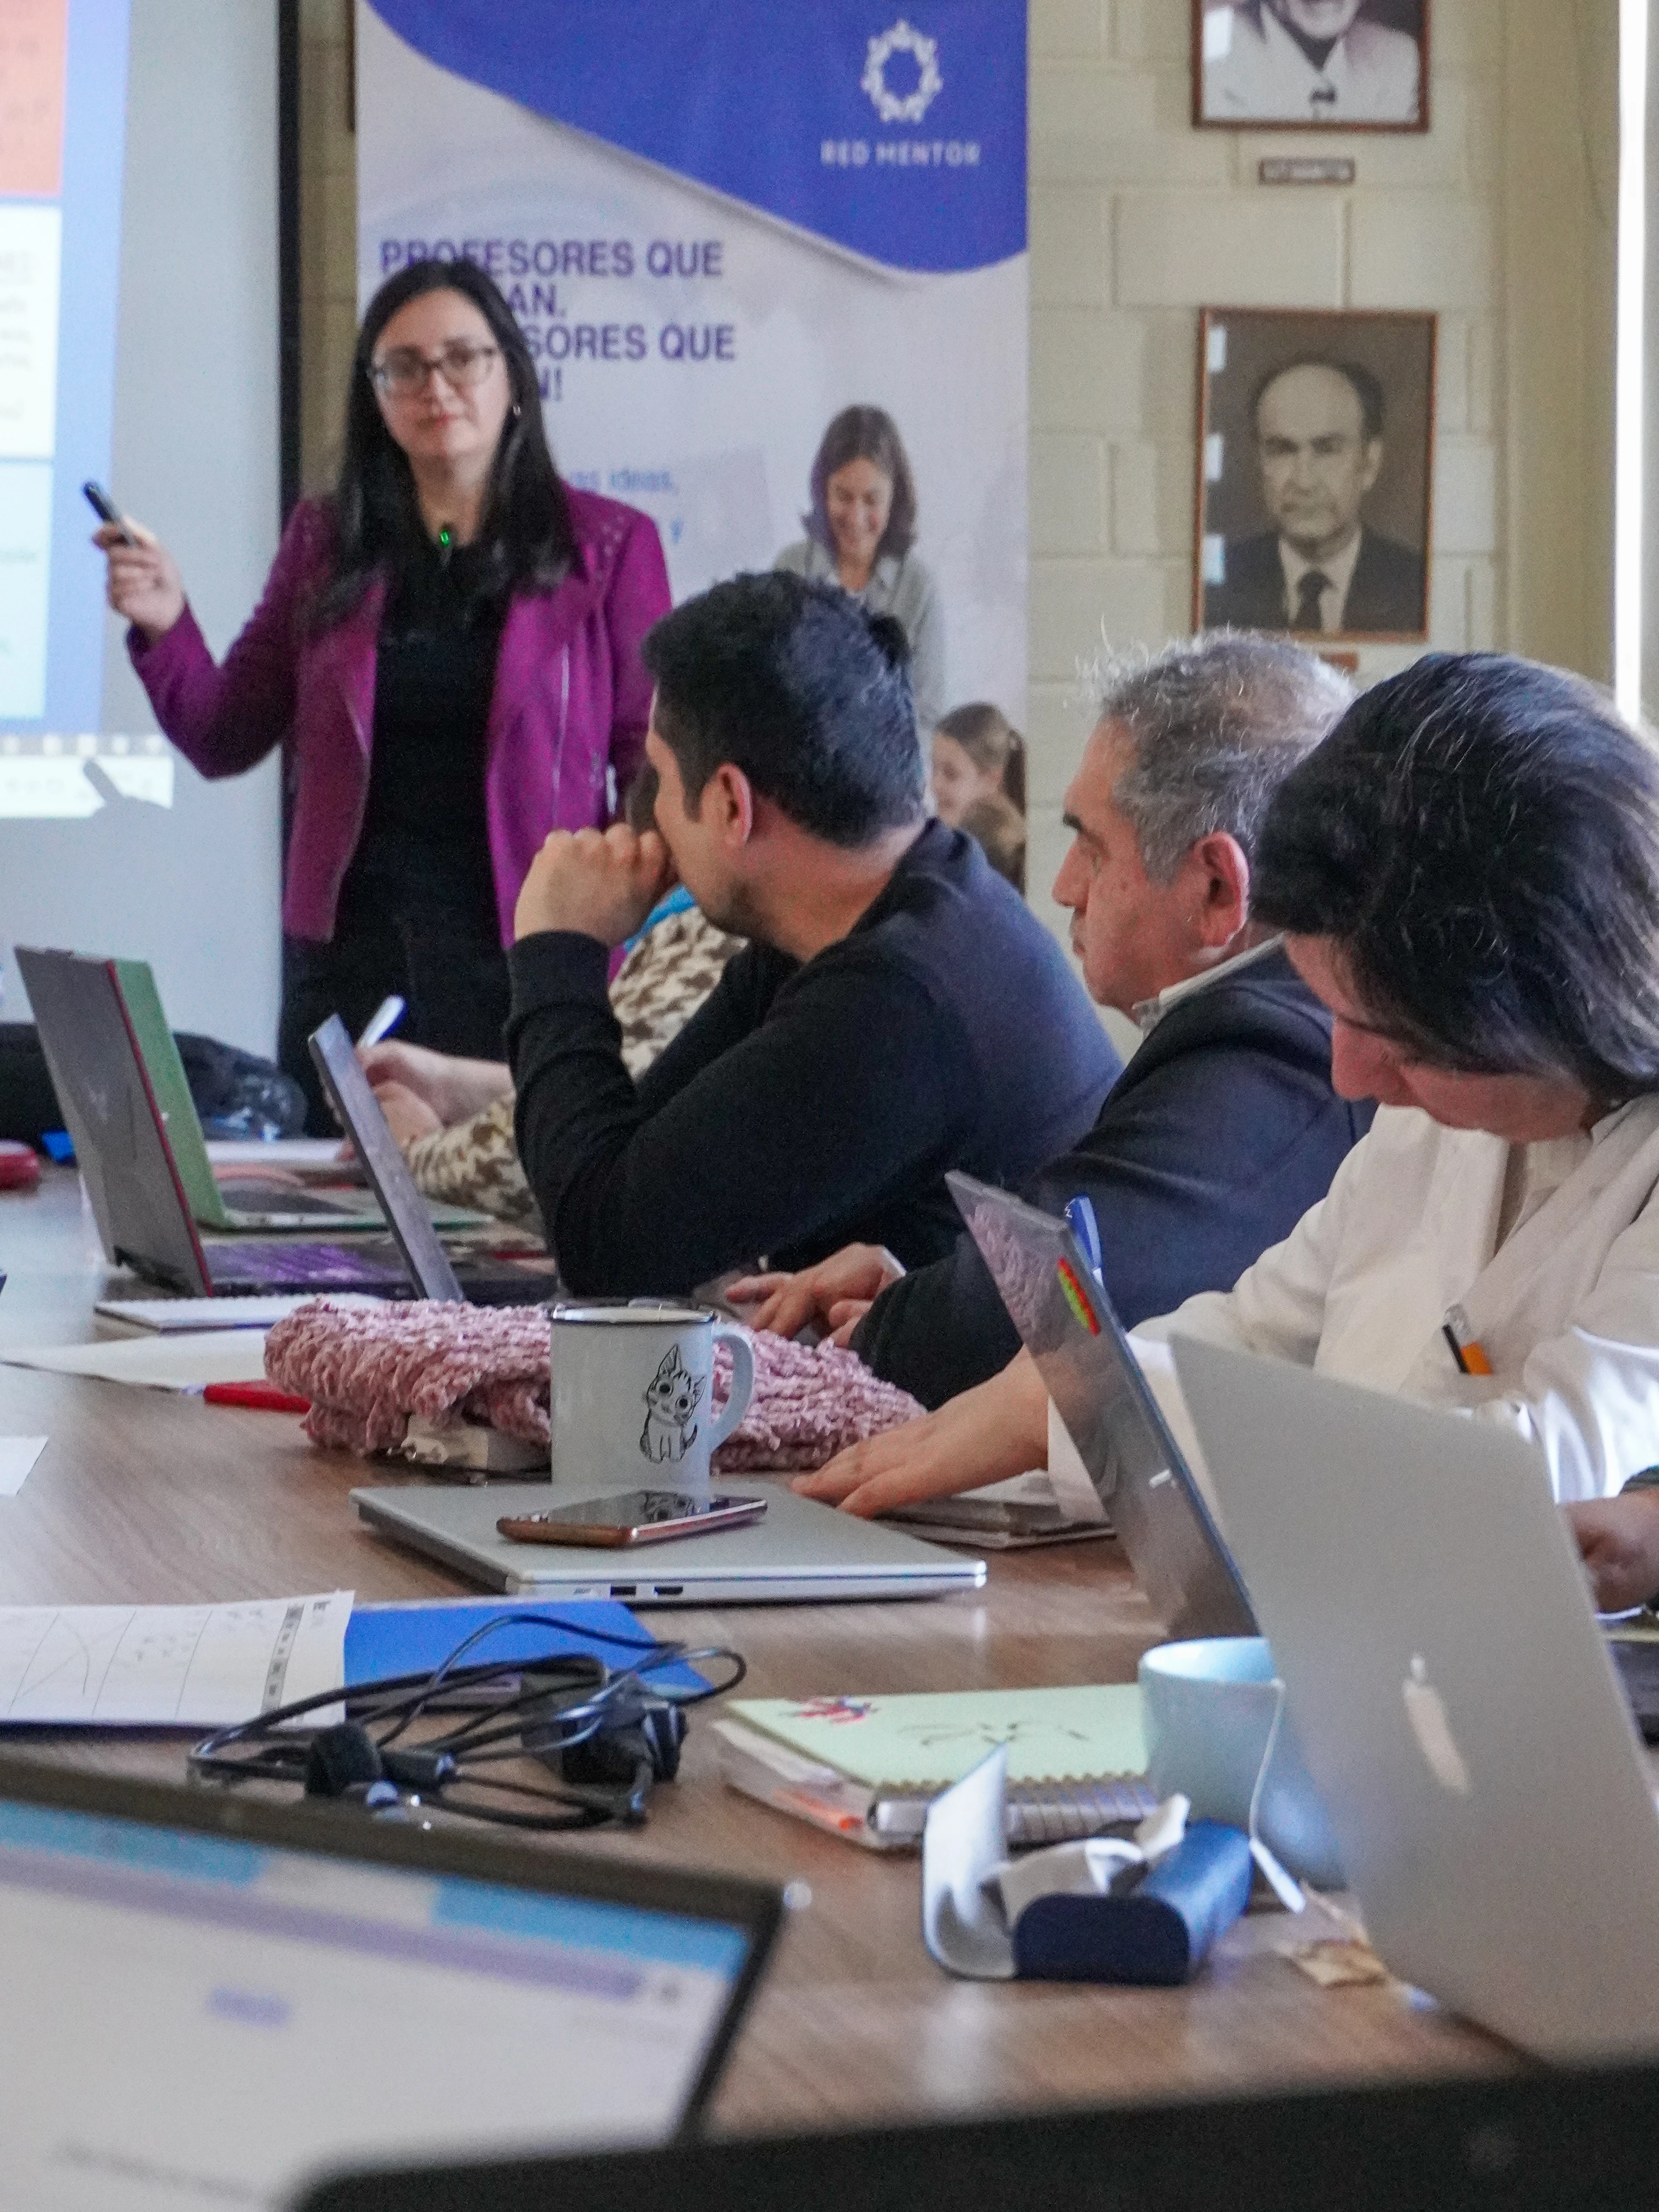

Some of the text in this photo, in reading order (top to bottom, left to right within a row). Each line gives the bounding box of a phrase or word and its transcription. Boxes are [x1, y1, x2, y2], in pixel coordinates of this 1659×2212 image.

[875, 140, 982, 167] MENTOR
[646, 240, 723, 278] QUE
[659, 324, 735, 360] QUE
